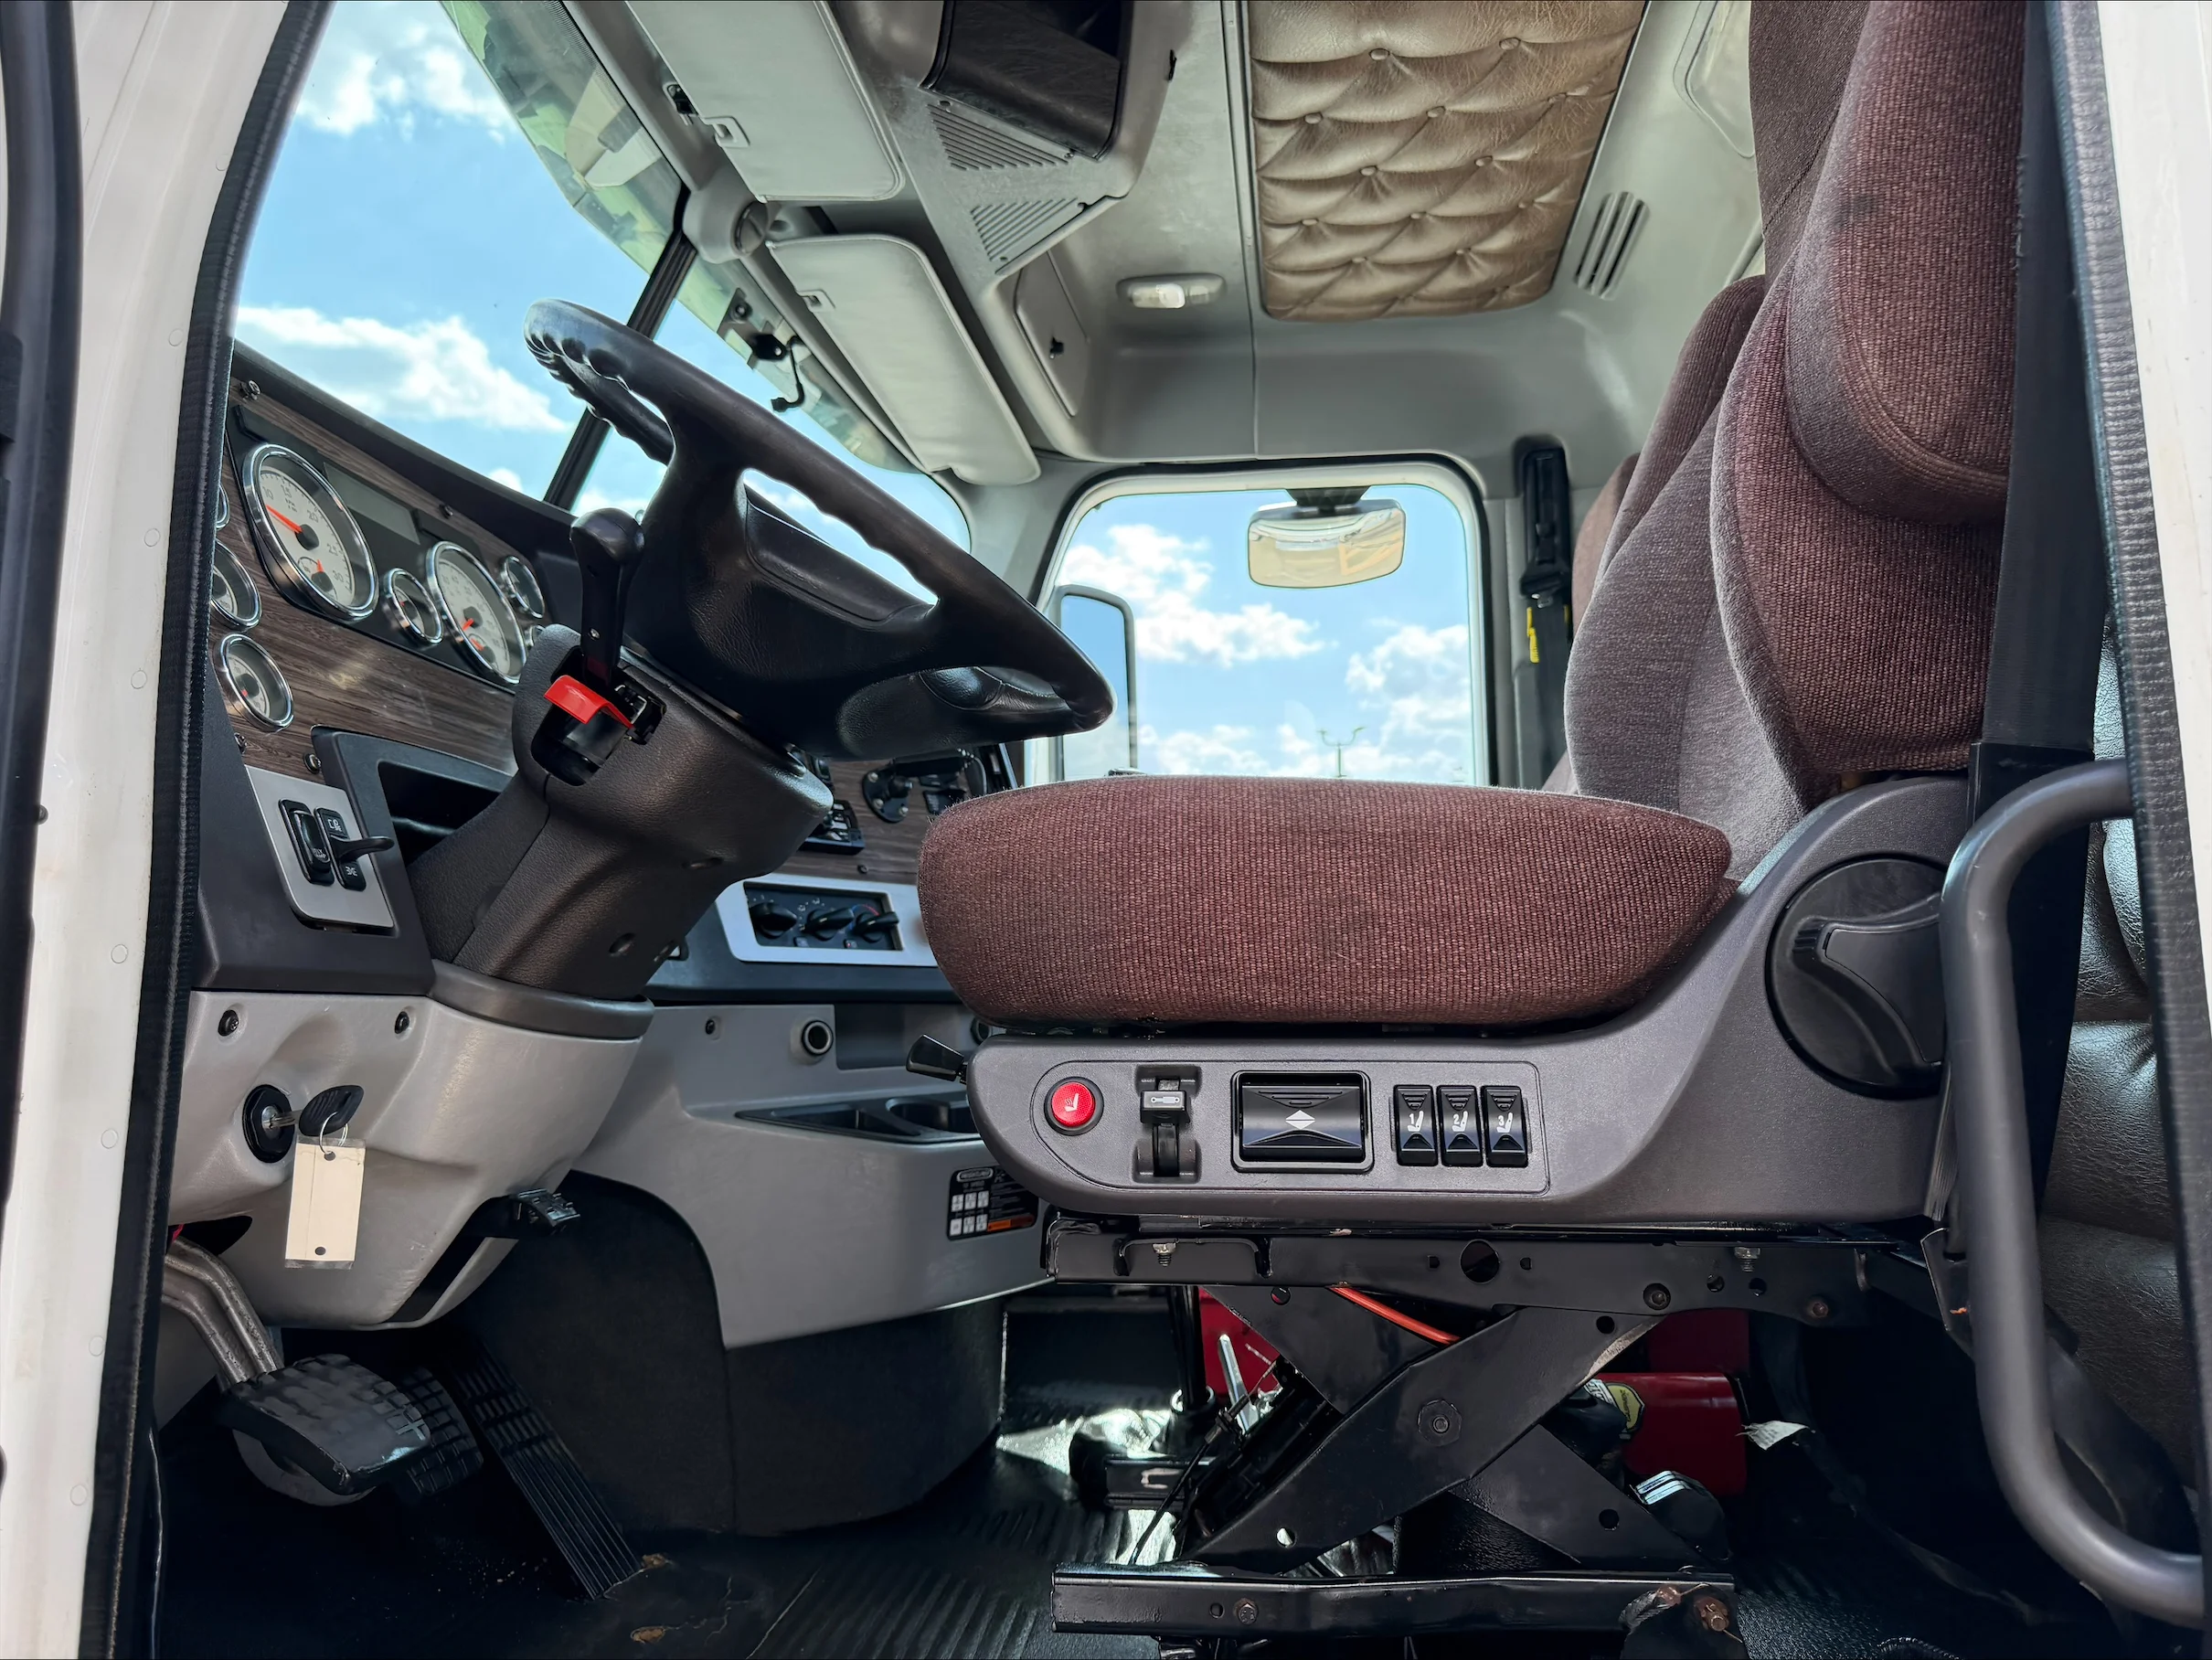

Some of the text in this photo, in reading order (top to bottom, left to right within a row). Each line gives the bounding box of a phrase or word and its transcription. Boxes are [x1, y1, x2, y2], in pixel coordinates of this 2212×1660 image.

[307, 509, 319, 523] 20
[1409, 1112, 1415, 1124] 1
[1452, 1113, 1461, 1125] 2
[1498, 1114, 1505, 1126] 3
